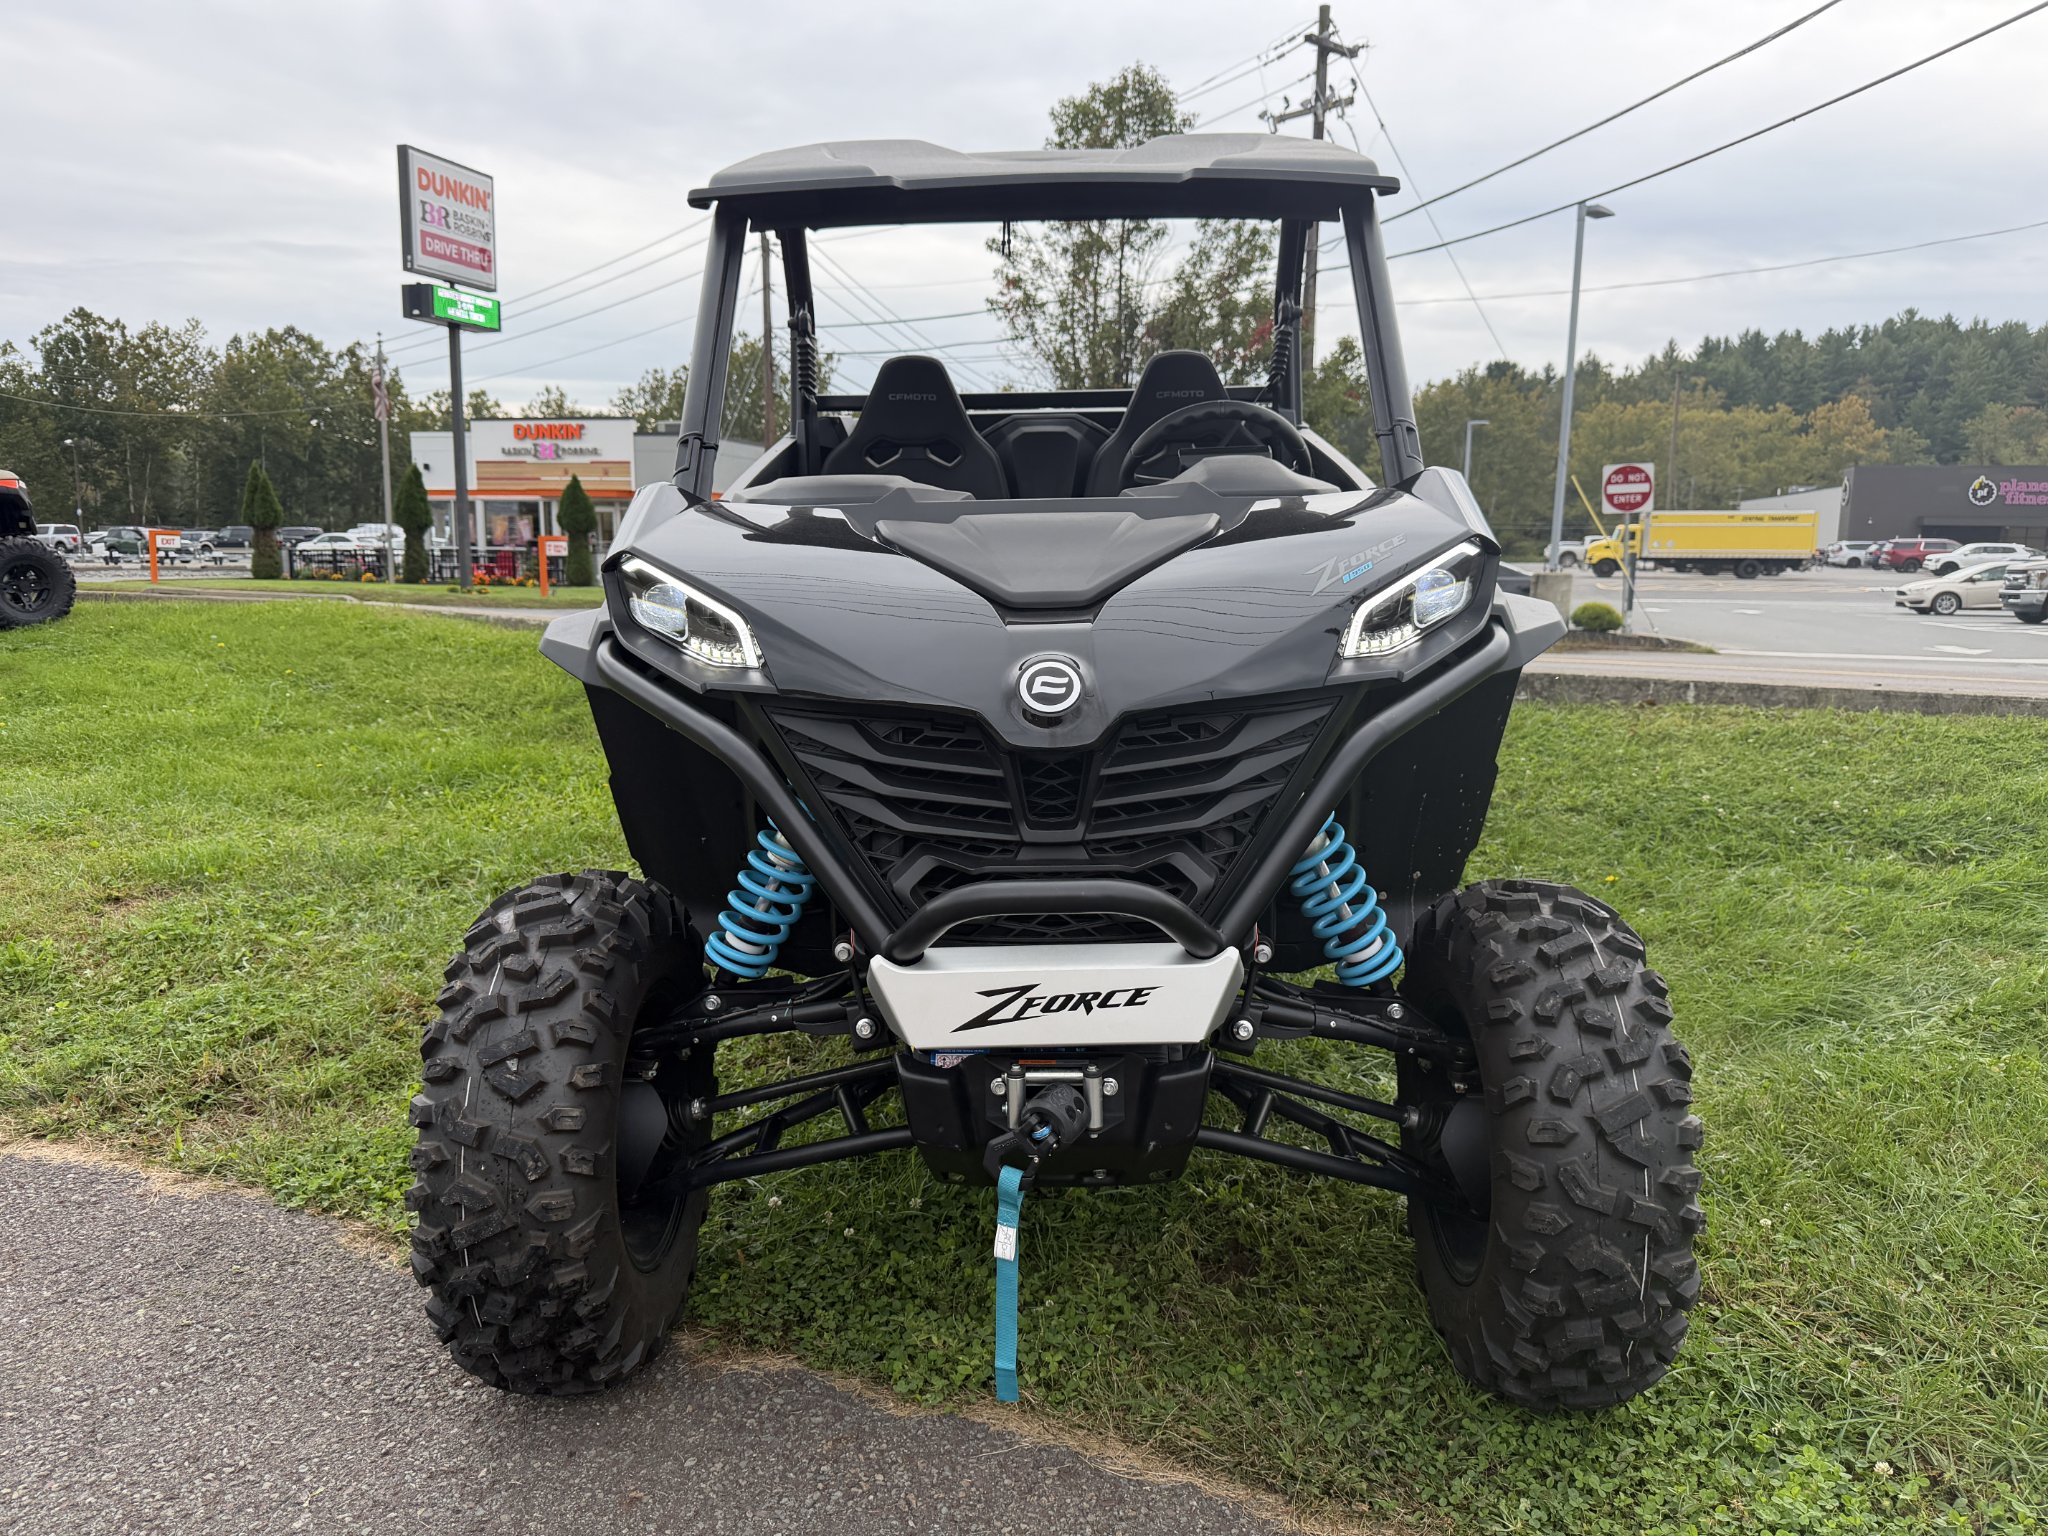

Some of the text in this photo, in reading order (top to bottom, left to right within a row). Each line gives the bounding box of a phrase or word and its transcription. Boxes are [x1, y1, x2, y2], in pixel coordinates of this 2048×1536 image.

[417, 166, 490, 212] DUNKIN'
[420, 199, 451, 230] BR
[453, 222, 491, 242] ROBBINS
[425, 236, 488, 267] DRIVE THRU
[888, 393, 937, 401] CFMOTO
[1156, 390, 1205, 399] CFMOTO
[1610, 472, 1646, 483] DO NOT
[1613, 494, 1642, 504] ENTER
[2005, 491, 2048, 505] fitne
[161, 537, 176, 545] EXIT
